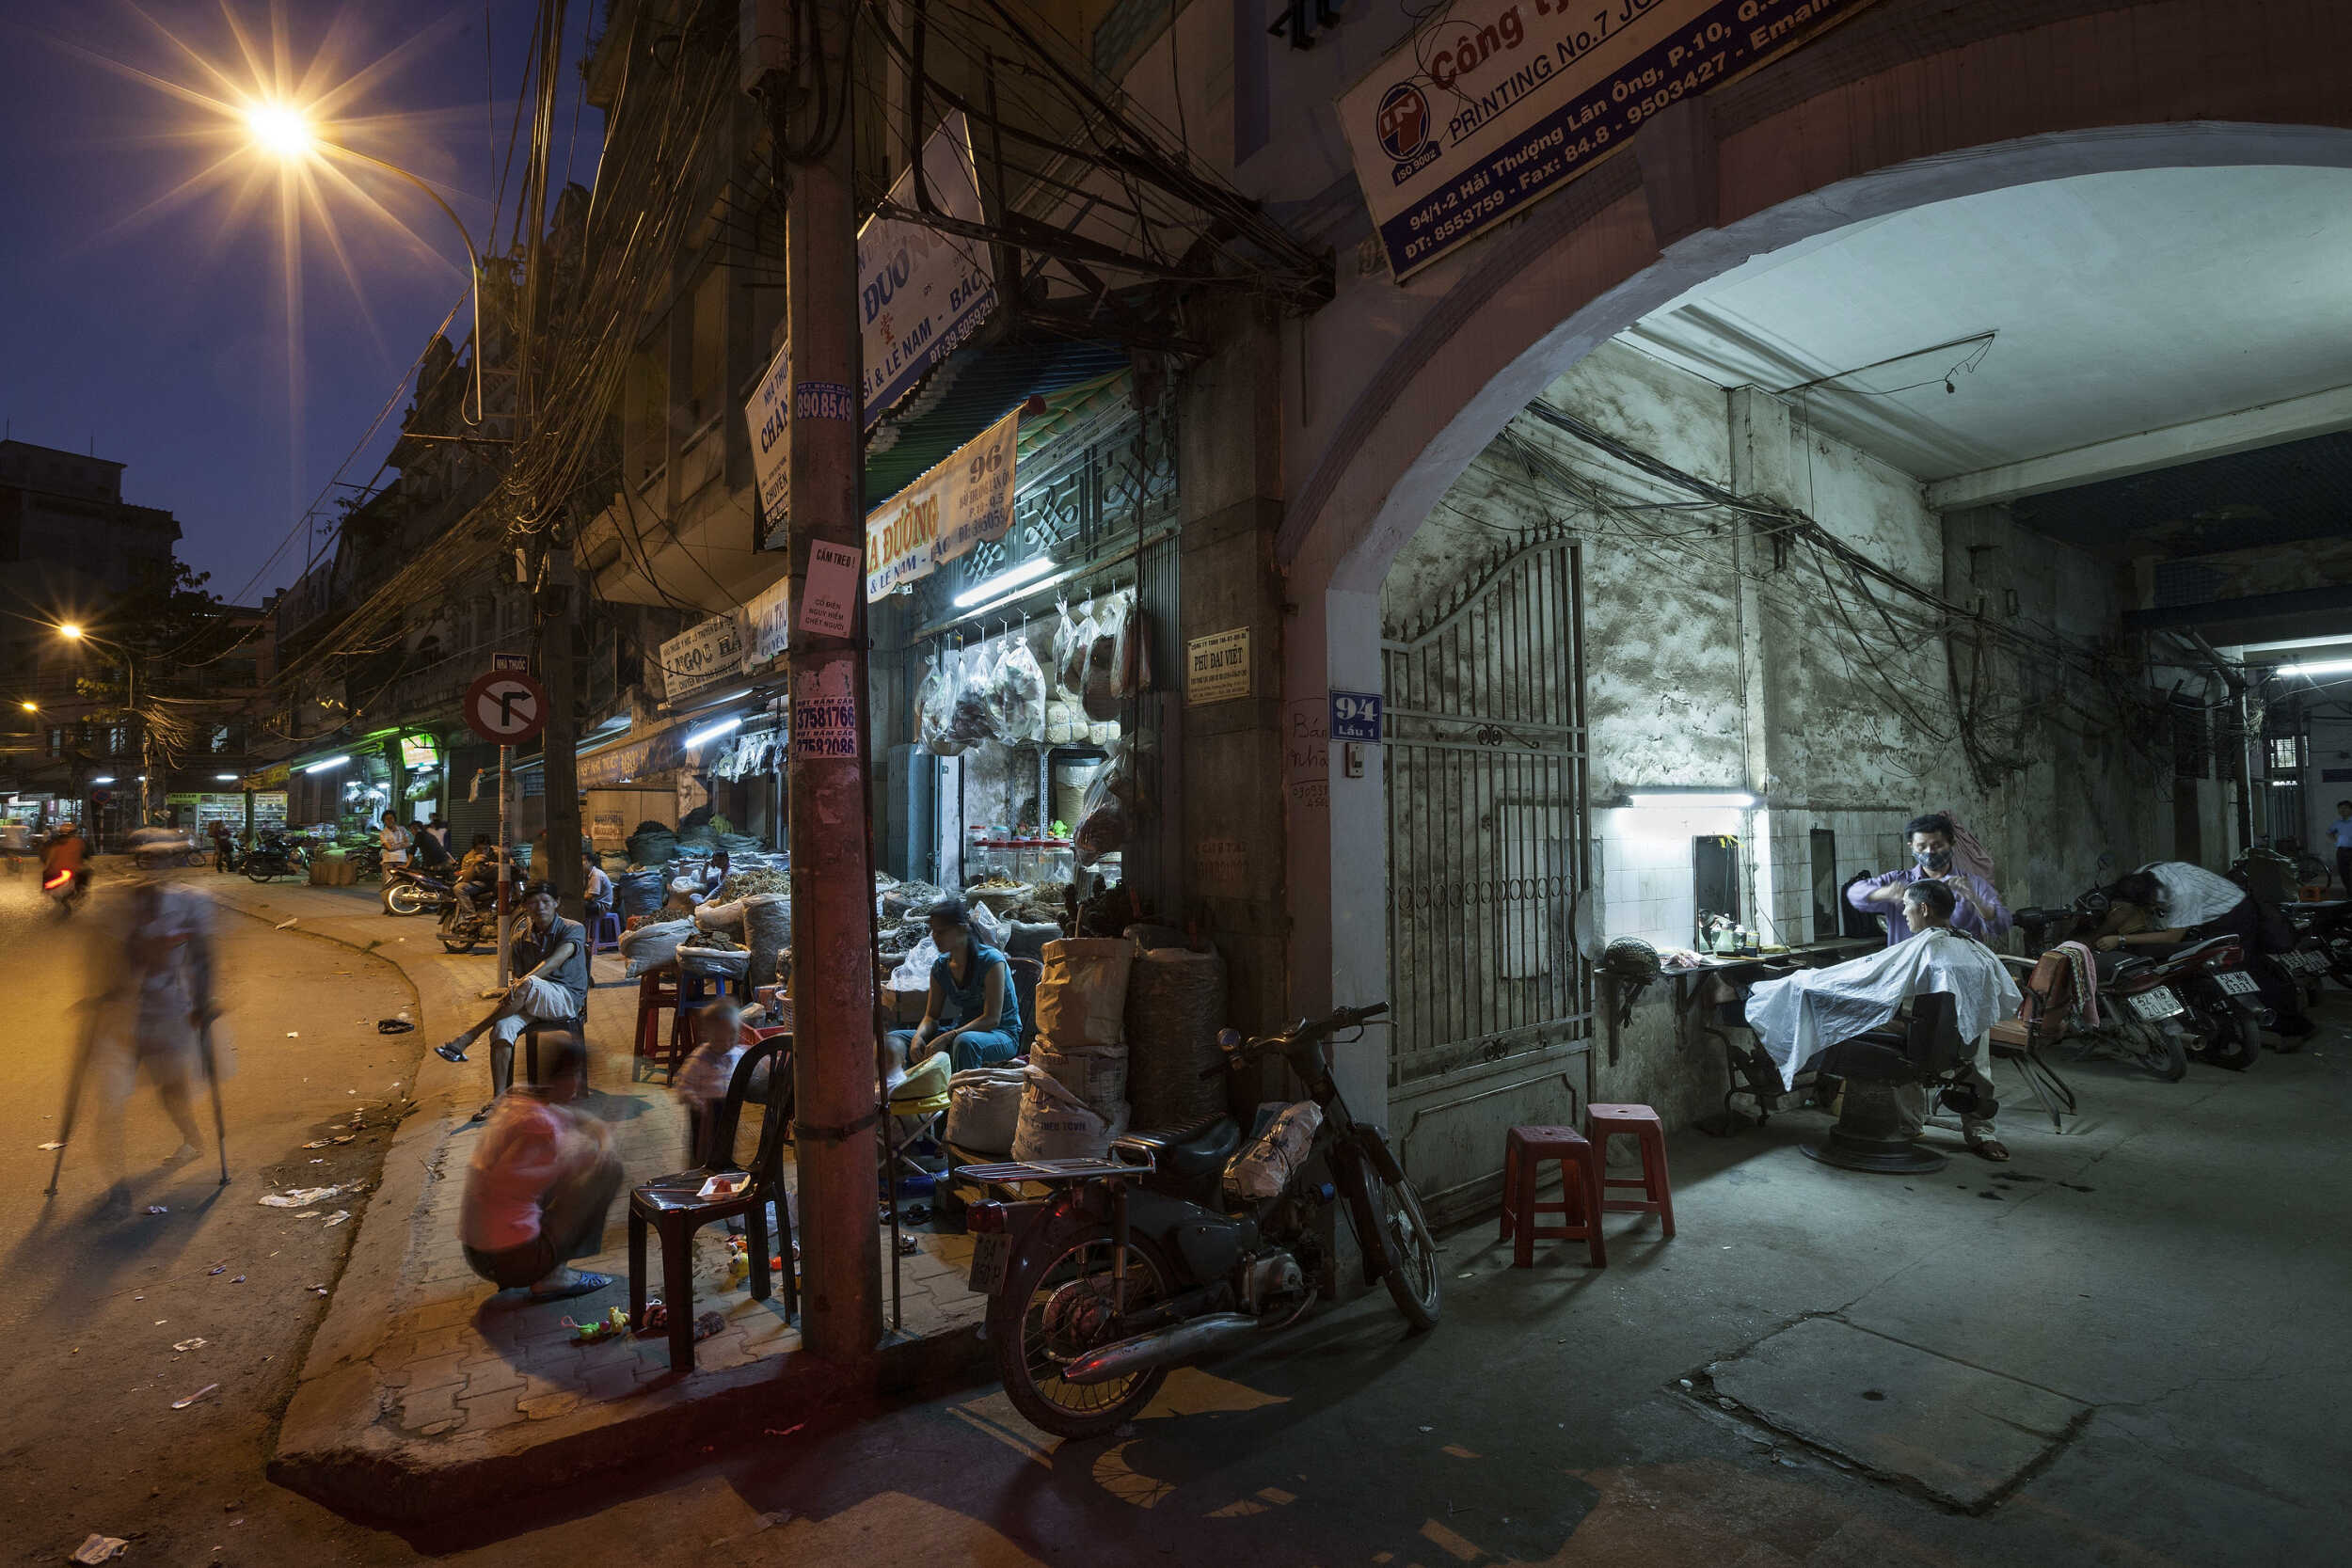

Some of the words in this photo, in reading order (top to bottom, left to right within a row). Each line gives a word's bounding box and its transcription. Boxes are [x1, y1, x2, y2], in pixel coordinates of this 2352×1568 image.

[1432, 6, 1524, 90] Công
[1449, 55, 1551, 141] PRINTING
[1556, 10, 1609, 64] No.7
[1409, 192, 1459, 230] 94/1-2
[1491, 126, 1565, 178] Thượng
[1567, 99, 1608, 133] Lãn
[1612, 65, 1664, 103] Ông,
[1667, 22, 1732, 69] P.10,
[1396, 165, 1412, 182] ISO
[1414, 149, 1438, 172] 9002
[1405, 234, 1433, 261] ĐT:
[1435, 189, 1505, 242] 8553759
[1518, 157, 1563, 190] Fax:
[1565, 125, 1610, 162] 84.8
[1627, 51, 1727, 125] 9503427
[876, 367, 884, 385] &
[903, 316, 932, 359] NAM
[970, 444, 1002, 484] 96
[870, 578, 877, 594] &
[894, 554, 916, 578] NAM
[797, 705, 854, 730] 37581766
[1336, 697, 1378, 722] 94
[1367, 728, 1374, 737] 1
